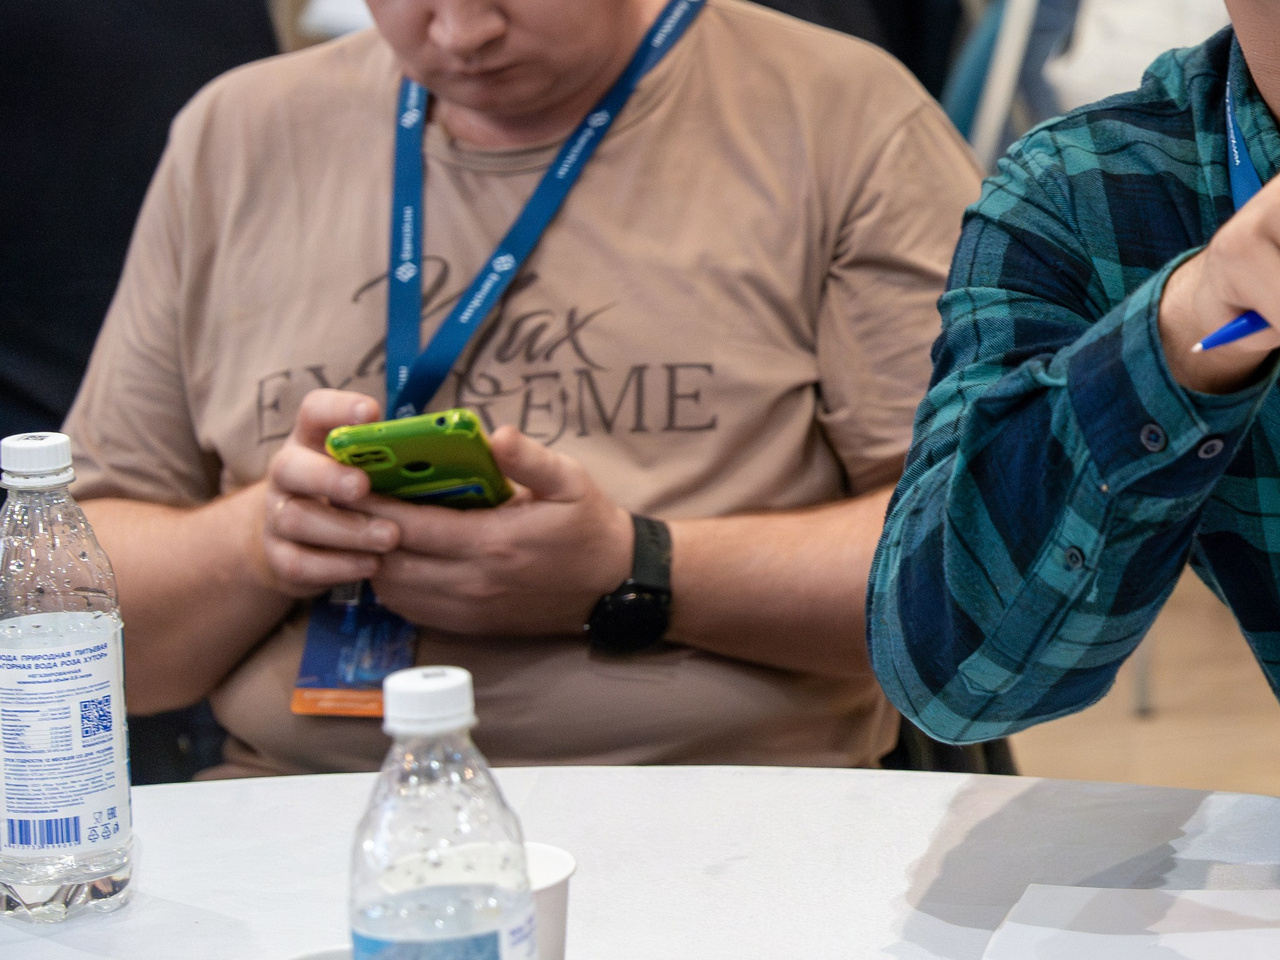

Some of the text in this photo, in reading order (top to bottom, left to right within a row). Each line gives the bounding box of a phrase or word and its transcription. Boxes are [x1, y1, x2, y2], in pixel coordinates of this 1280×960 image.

[21, 651, 71, 662] ПРИРОДНАЯ
[34, 662, 58, 670] ВОДА
[60, 658, 82, 667] РОЗА
